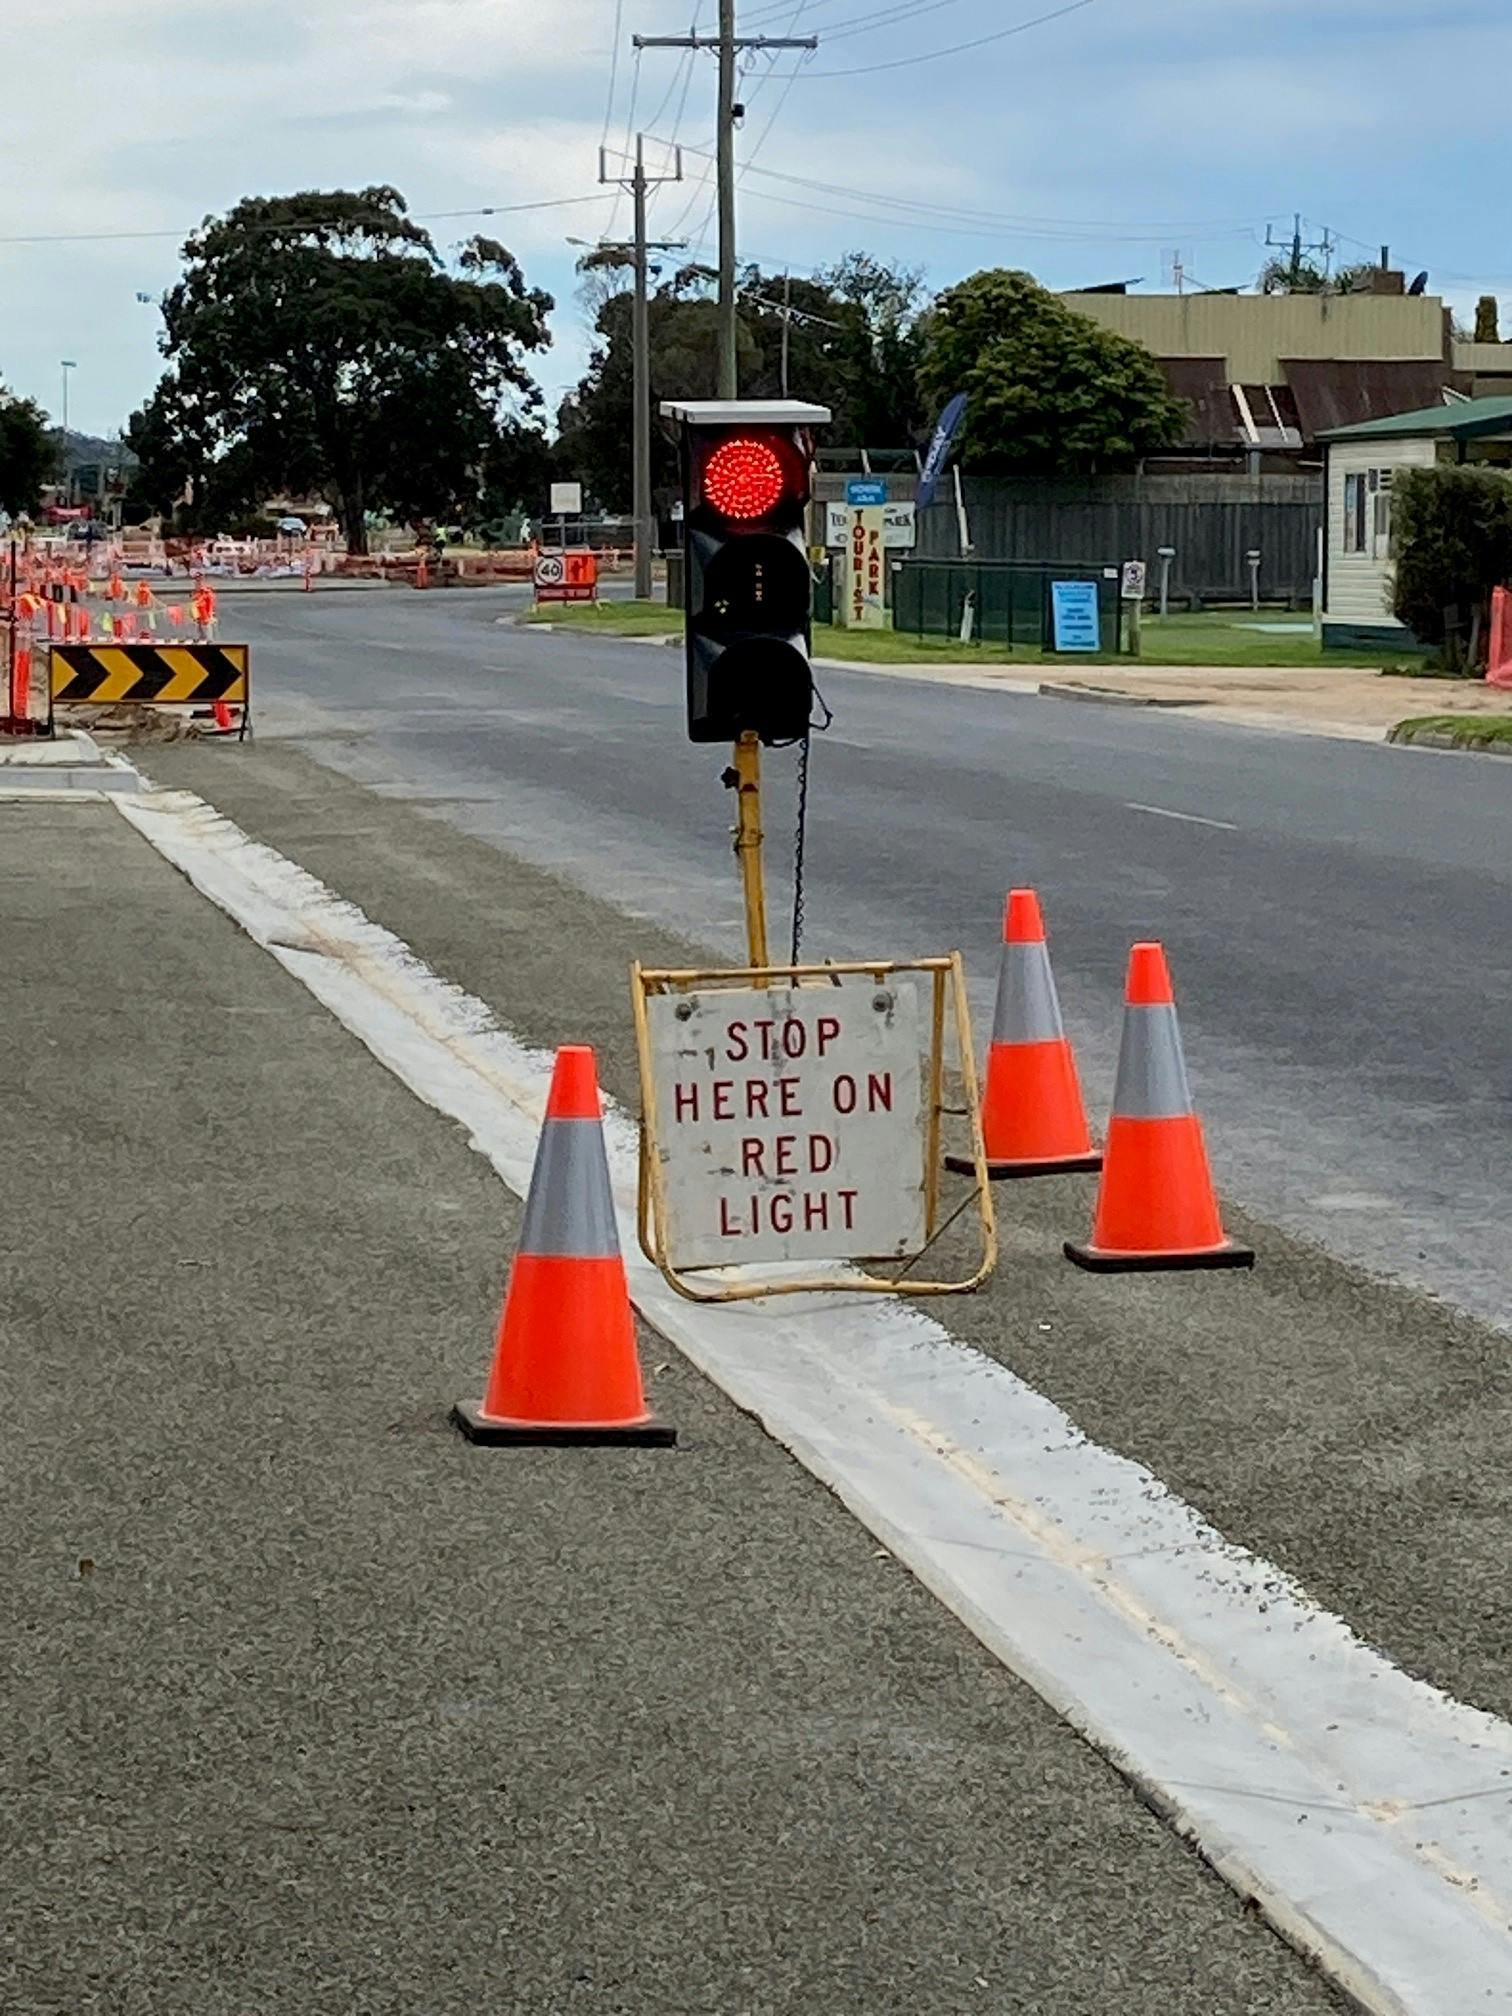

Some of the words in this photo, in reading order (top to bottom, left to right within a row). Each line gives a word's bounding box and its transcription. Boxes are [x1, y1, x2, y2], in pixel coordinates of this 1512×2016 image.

[541, 563, 560, 577] 40
[853, 508, 866, 621] TOURIST
[868, 530, 880, 596] PARK
[726, 1017, 841, 1062] STOP
[675, 1076, 802, 1123] HERE
[833, 1072, 893, 1114] ON
[742, 1134, 833, 1177] RED
[719, 1190, 858, 1237] LIGHT
